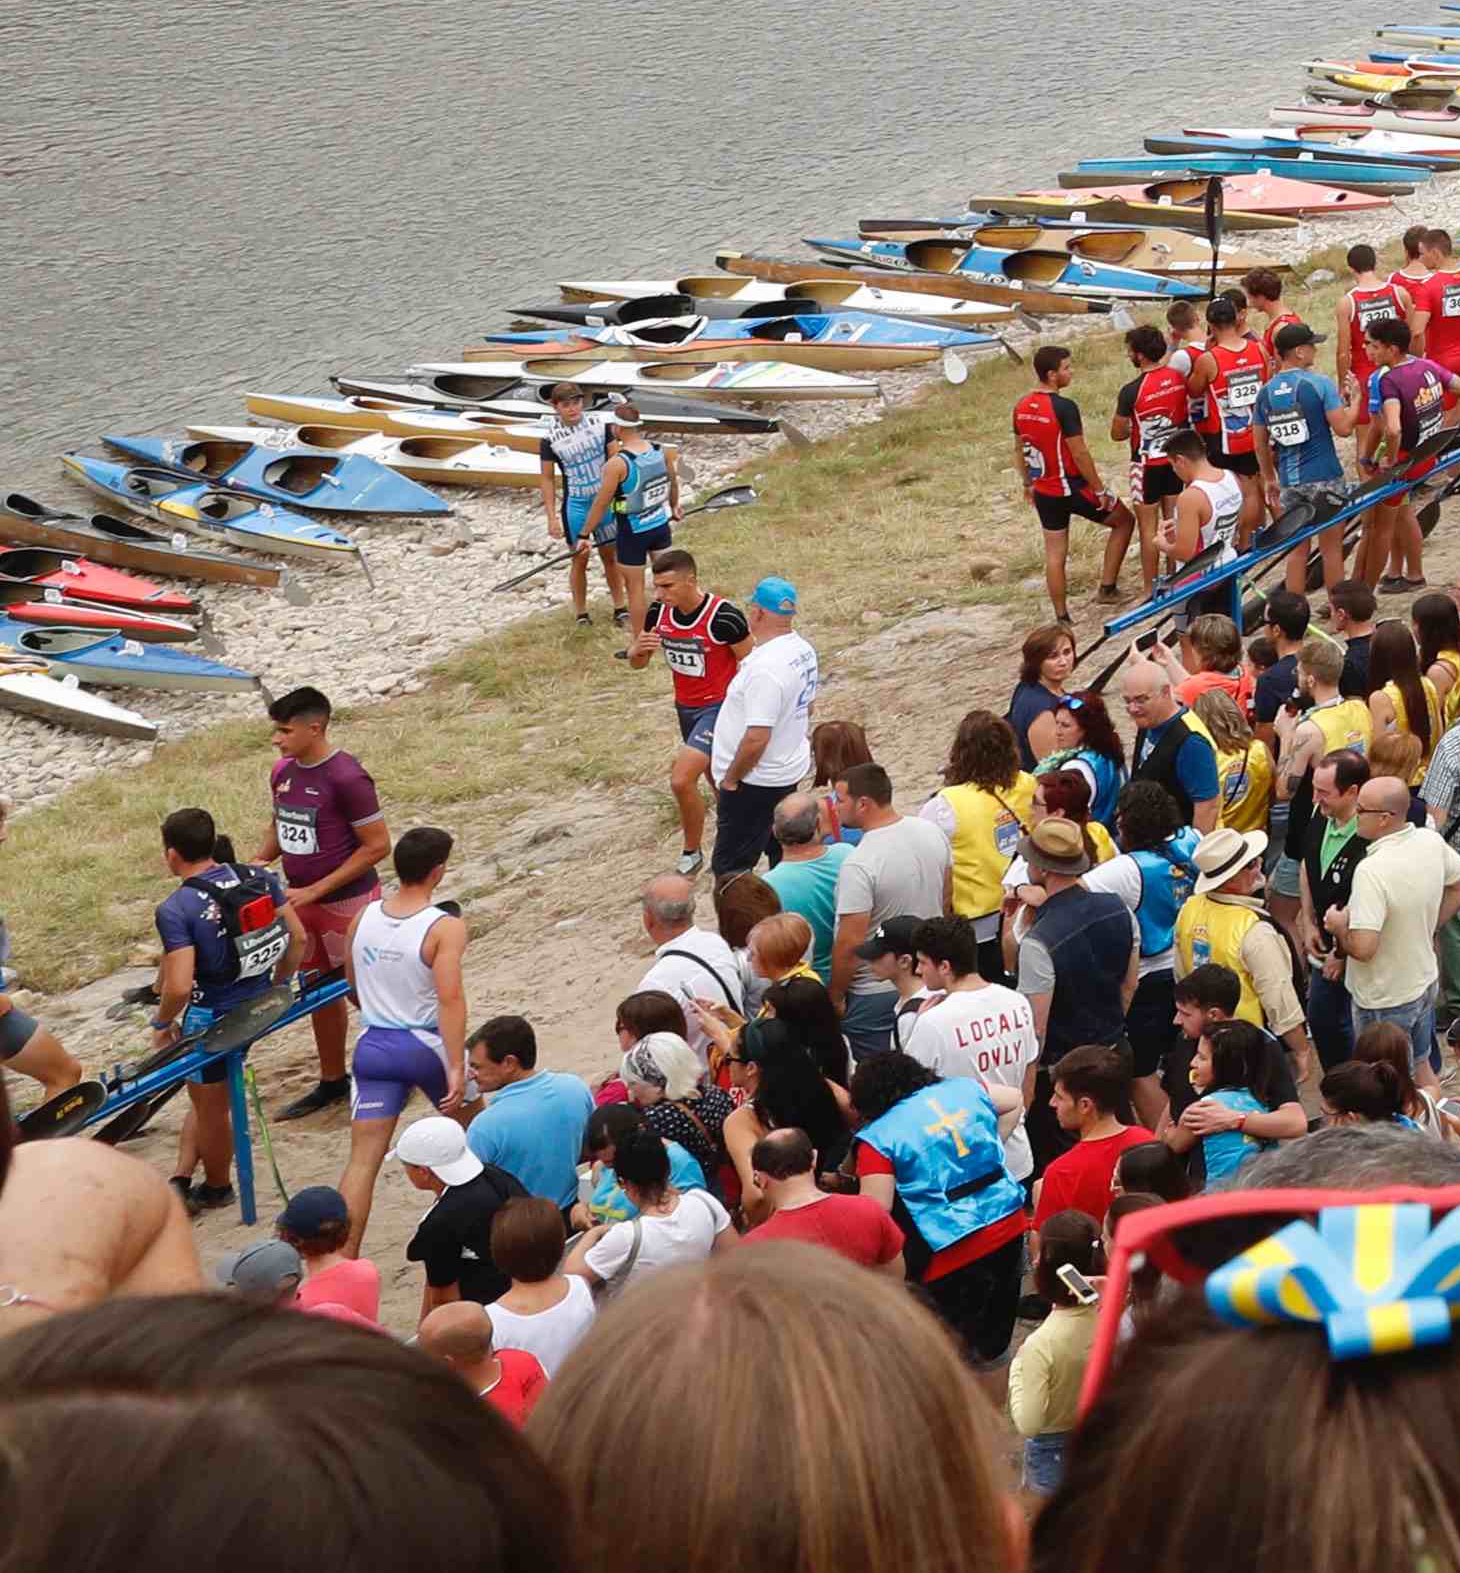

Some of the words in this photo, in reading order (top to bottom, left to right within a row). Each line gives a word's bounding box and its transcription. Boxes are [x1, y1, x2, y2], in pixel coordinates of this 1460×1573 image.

[1234, 384, 1257, 399] 328
[1273, 423, 1300, 438] 318
[669, 651, 697, 668] 311
[281, 824, 308, 843] 324
[248, 941, 281, 970] 325
[955, 1005, 1030, 1049] LOCALS
